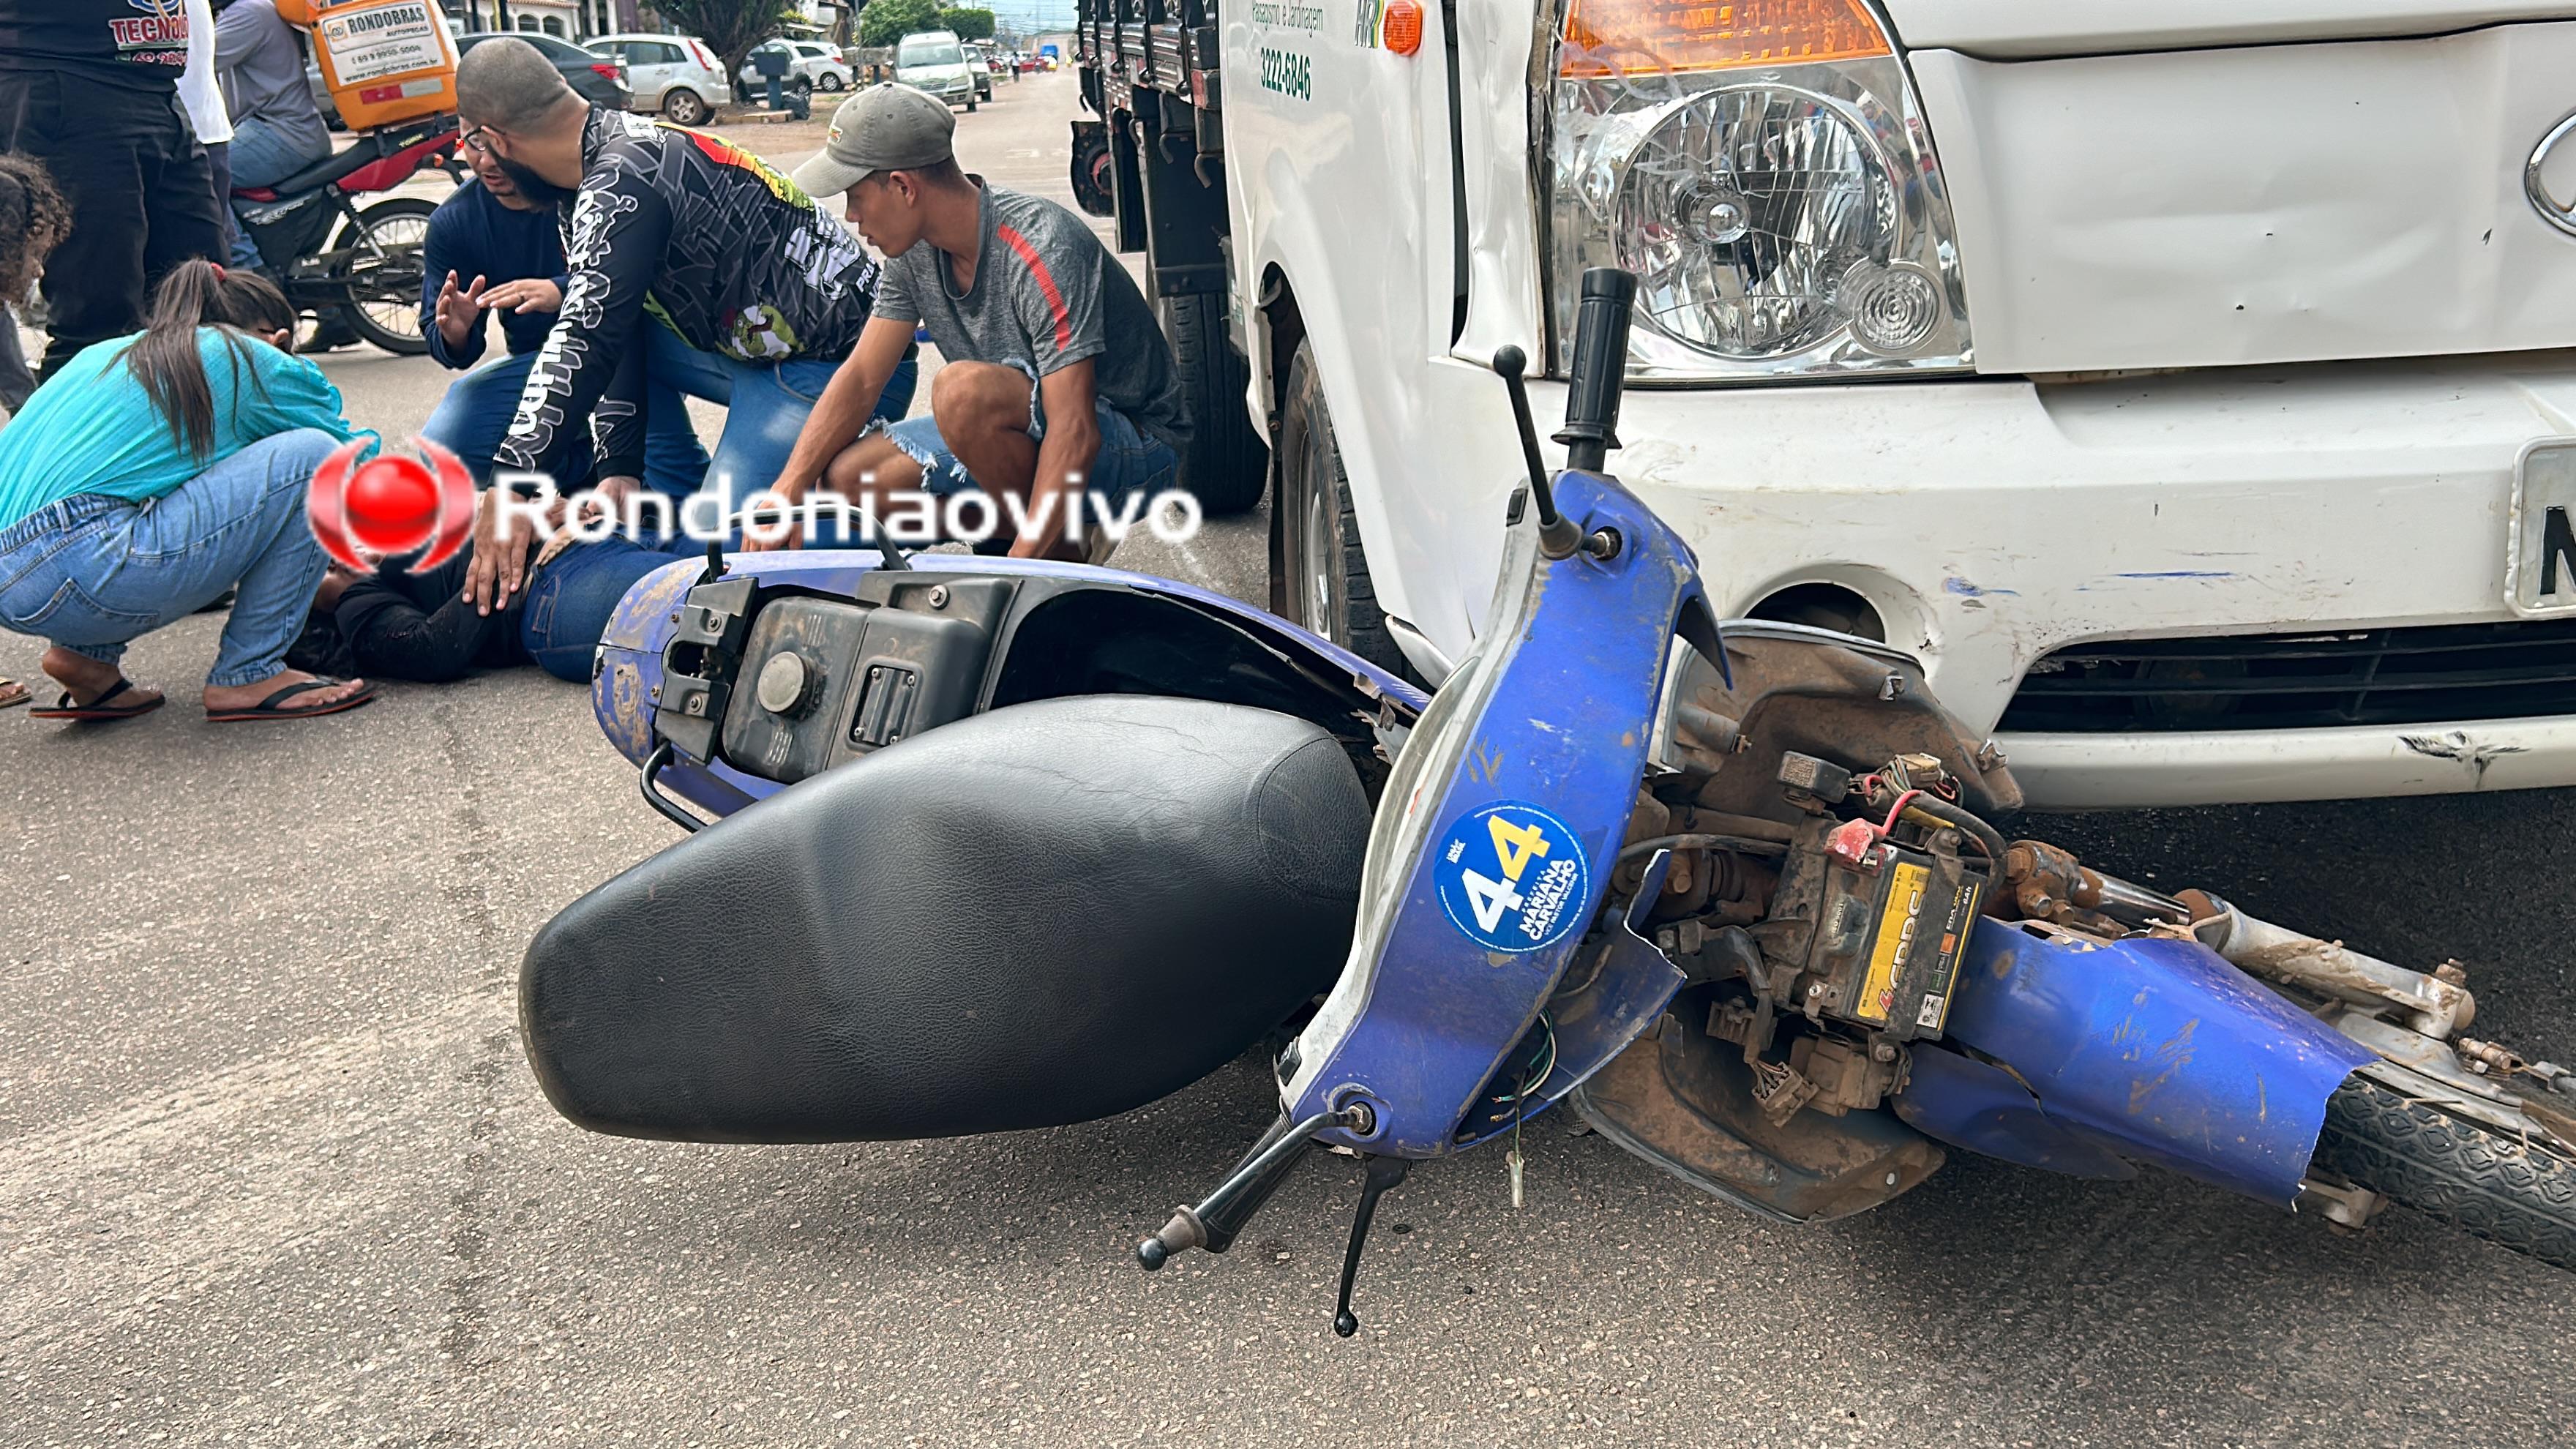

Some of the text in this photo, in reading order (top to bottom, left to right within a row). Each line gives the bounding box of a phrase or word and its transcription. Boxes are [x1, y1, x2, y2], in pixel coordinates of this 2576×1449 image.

[348, 7, 426, 34] RONDOBRAS
[1282, 4, 1287, 26] e
[1287, 0, 1323, 38] Jardinagem
[1355, 0, 1380, 48] HR
[1261, 47, 1311, 101] 3222-6846
[1461, 814, 1551, 934] 44
[1519, 860, 1564, 933] MARIANA
[1530, 859, 1576, 940] CARVALHO
